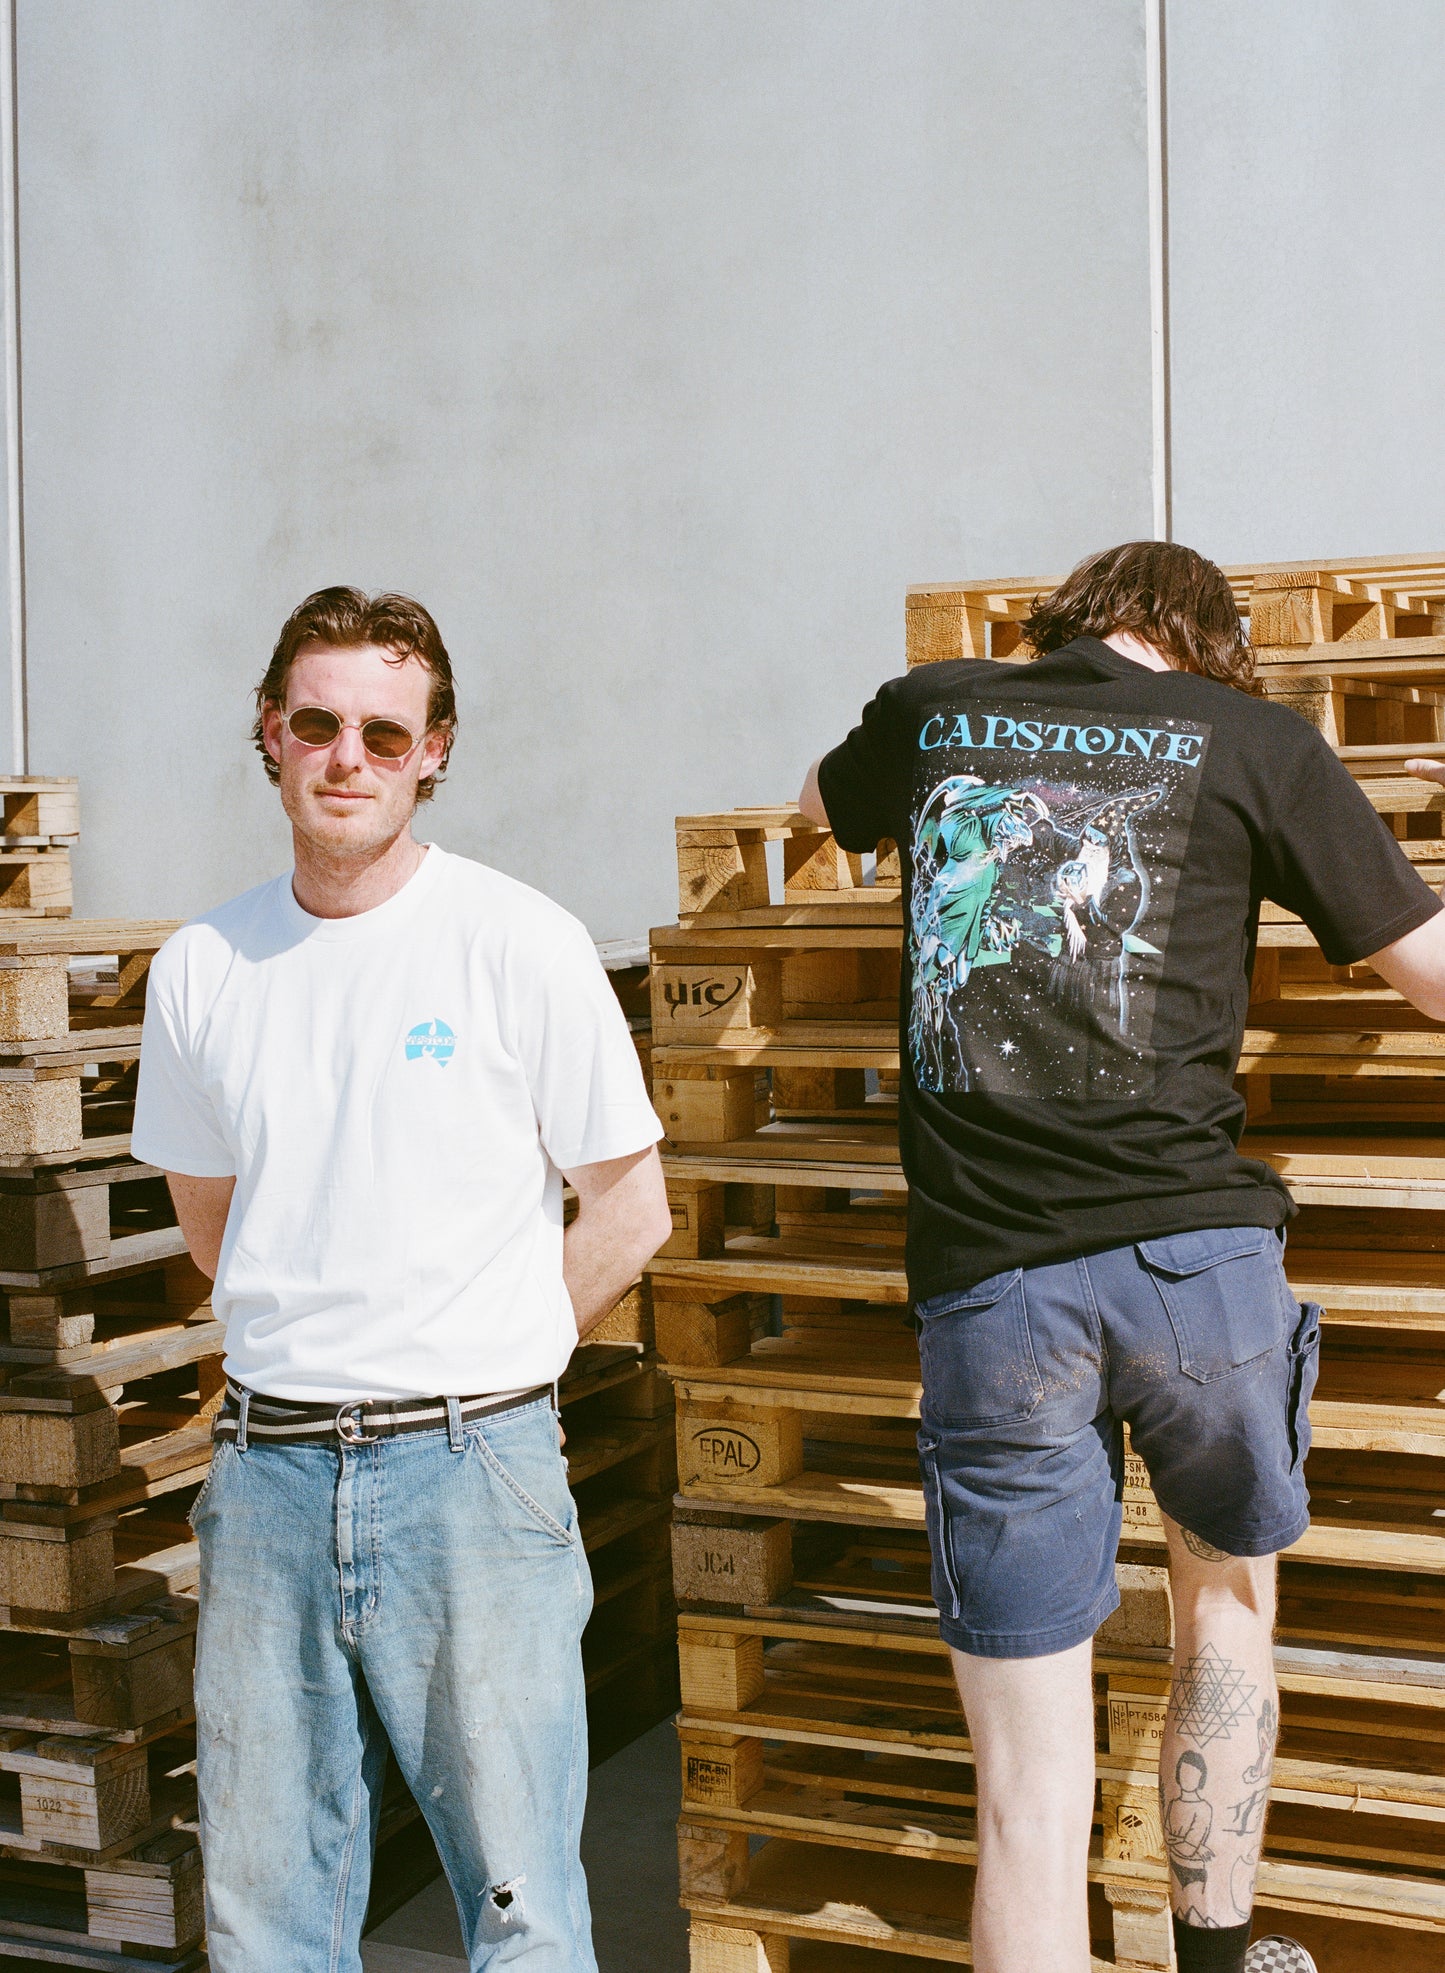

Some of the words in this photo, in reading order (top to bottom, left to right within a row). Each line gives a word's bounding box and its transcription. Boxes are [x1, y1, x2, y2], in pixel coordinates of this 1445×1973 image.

[918, 713, 1204, 767] CAPSTONE
[700, 1438, 750, 1468] EPAL
[1133, 1728, 1146, 1738] HT
[36, 1798, 62, 1813] 1022
